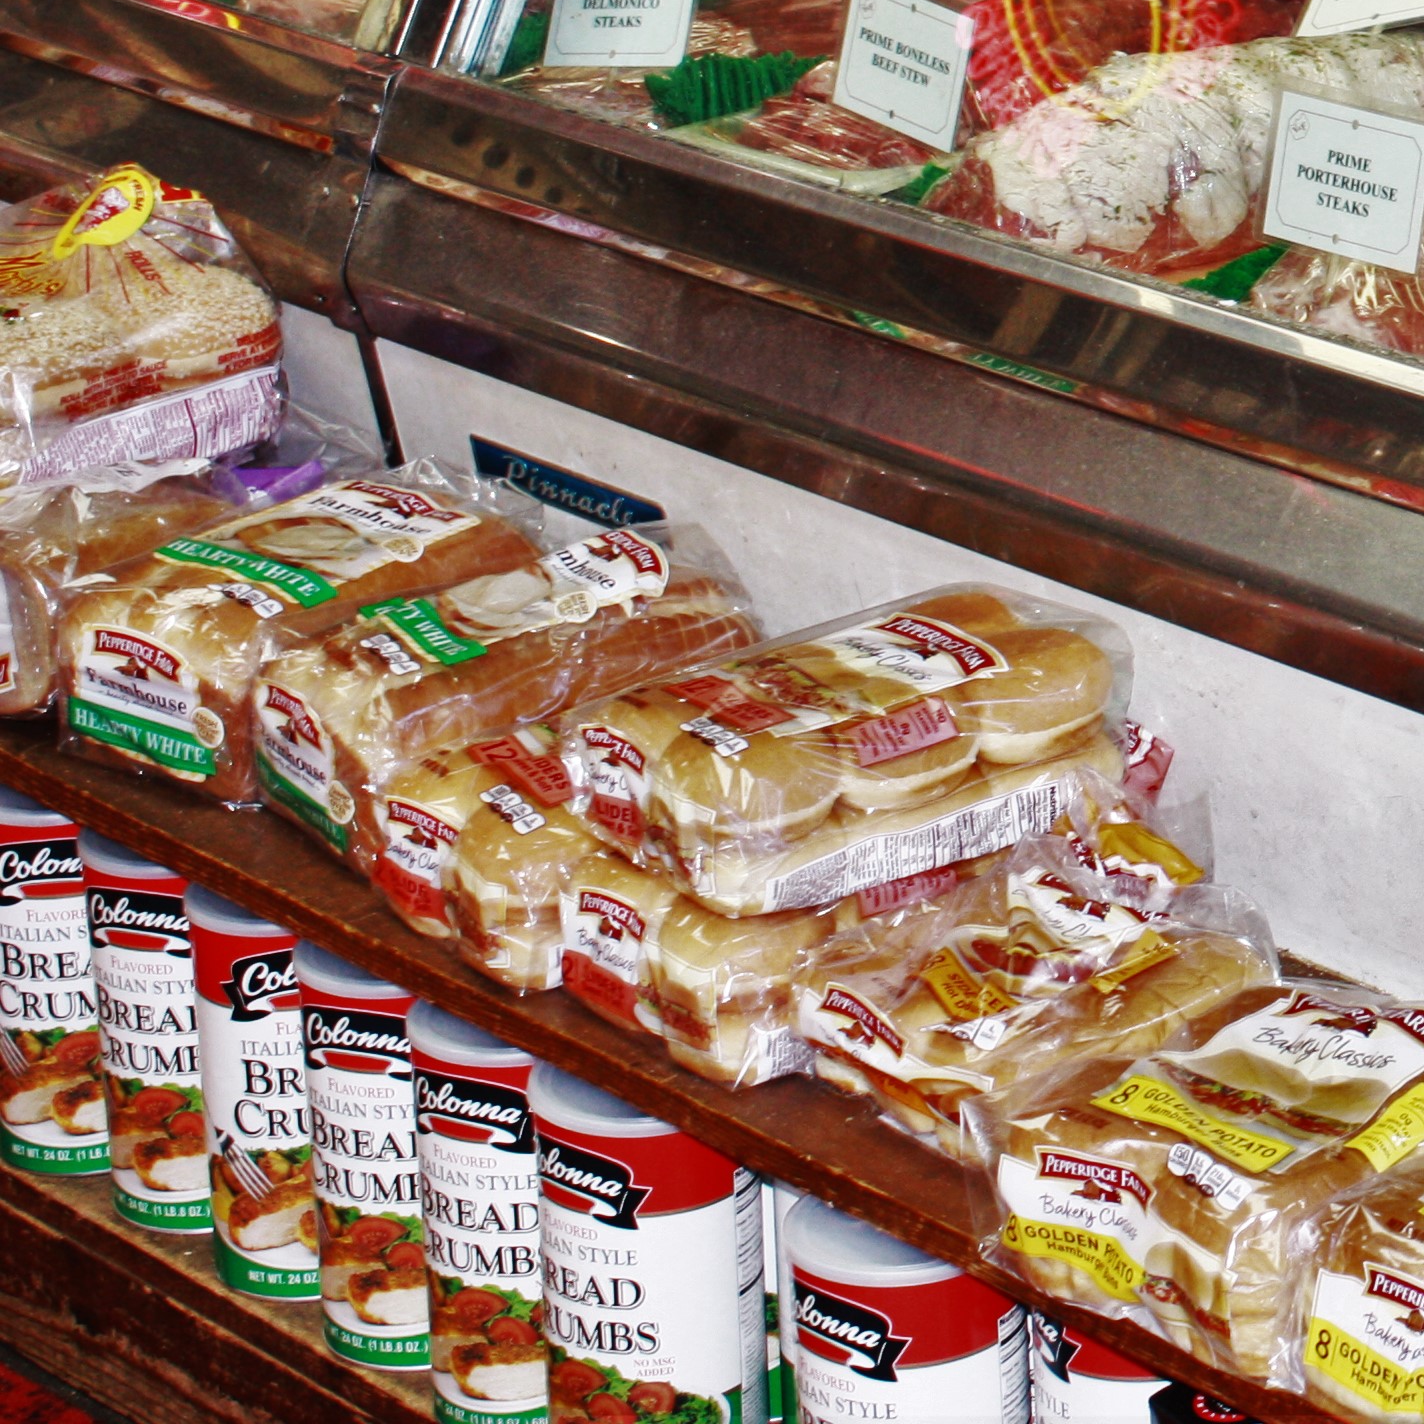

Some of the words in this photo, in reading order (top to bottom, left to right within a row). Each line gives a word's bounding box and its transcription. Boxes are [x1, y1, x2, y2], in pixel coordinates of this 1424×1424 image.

[593, 15, 642, 28] STEAKS
[859, 26, 893, 54] PRIME
[896, 43, 950, 76] BONELESS
[871, 52, 898, 78] BEEF
[899, 65, 931, 88] STEW
[1327, 149, 1372, 173] PRIME
[1297, 164, 1398, 202] PORTERHOUSE
[1316, 193, 1370, 218] STEAKS
[503, 455, 634, 526] Pinnacle
[308, 495, 432, 535] Farmhouse
[169, 538, 246, 568] HEARTY
[249, 558, 321, 597] WHITE
[100, 632, 154, 661] PEPPERIDGE
[154, 650, 175, 676] FARM
[414, 621, 468, 656] WHITE
[887, 617, 961, 654] PEPPERIDGE
[960, 645, 985, 670] FARM
[86, 666, 188, 715] Farmhouse
[75, 707, 142, 744] HEARTY
[146, 731, 207, 765] WHITE
[391, 802, 436, 833] PEPPERIDGE
[111, 955, 173, 975] FLAVORED
[1253, 1027, 1320, 1063] Bakery
[1318, 1035, 1396, 1069] Classics
[328, 1077, 395, 1099] FLAVORED
[415, 1076, 521, 1124] Colonna
[1110, 1084, 1139, 1105] 8
[1211, 1125, 1278, 1159] POTATO
[43, 1150, 55, 1160] 24
[57, 1149, 73, 1161] OZ.
[433, 1144, 498, 1169] FLAVORED
[476, 1173, 538, 1191] STYLE
[1045, 1155, 1117, 1183] PEPPERIDGE
[1120, 1169, 1147, 1201] FARM
[423, 1177, 539, 1234] BREAD
[1040, 1193, 1096, 1227] Bakery
[578, 1246, 639, 1266] STYLE
[1005, 1214, 1018, 1243] 8
[1024, 1225, 1099, 1251] GOLDEN
[1104, 1242, 1134, 1282] POTATO
[248, 1270, 265, 1282] NET
[267, 1272, 286, 1284] WT.
[288, 1271, 301, 1284] 24
[1364, 1312, 1410, 1360] Bakery
[633, 1358, 650, 1368] NO
[653, 1355, 676, 1367] MSG
[636, 1365, 674, 1377] ADDED
[1315, 1329, 1331, 1359] 8
[1339, 1342, 1401, 1390] GOLDEN
[835, 1397, 898, 1420] STYLE
